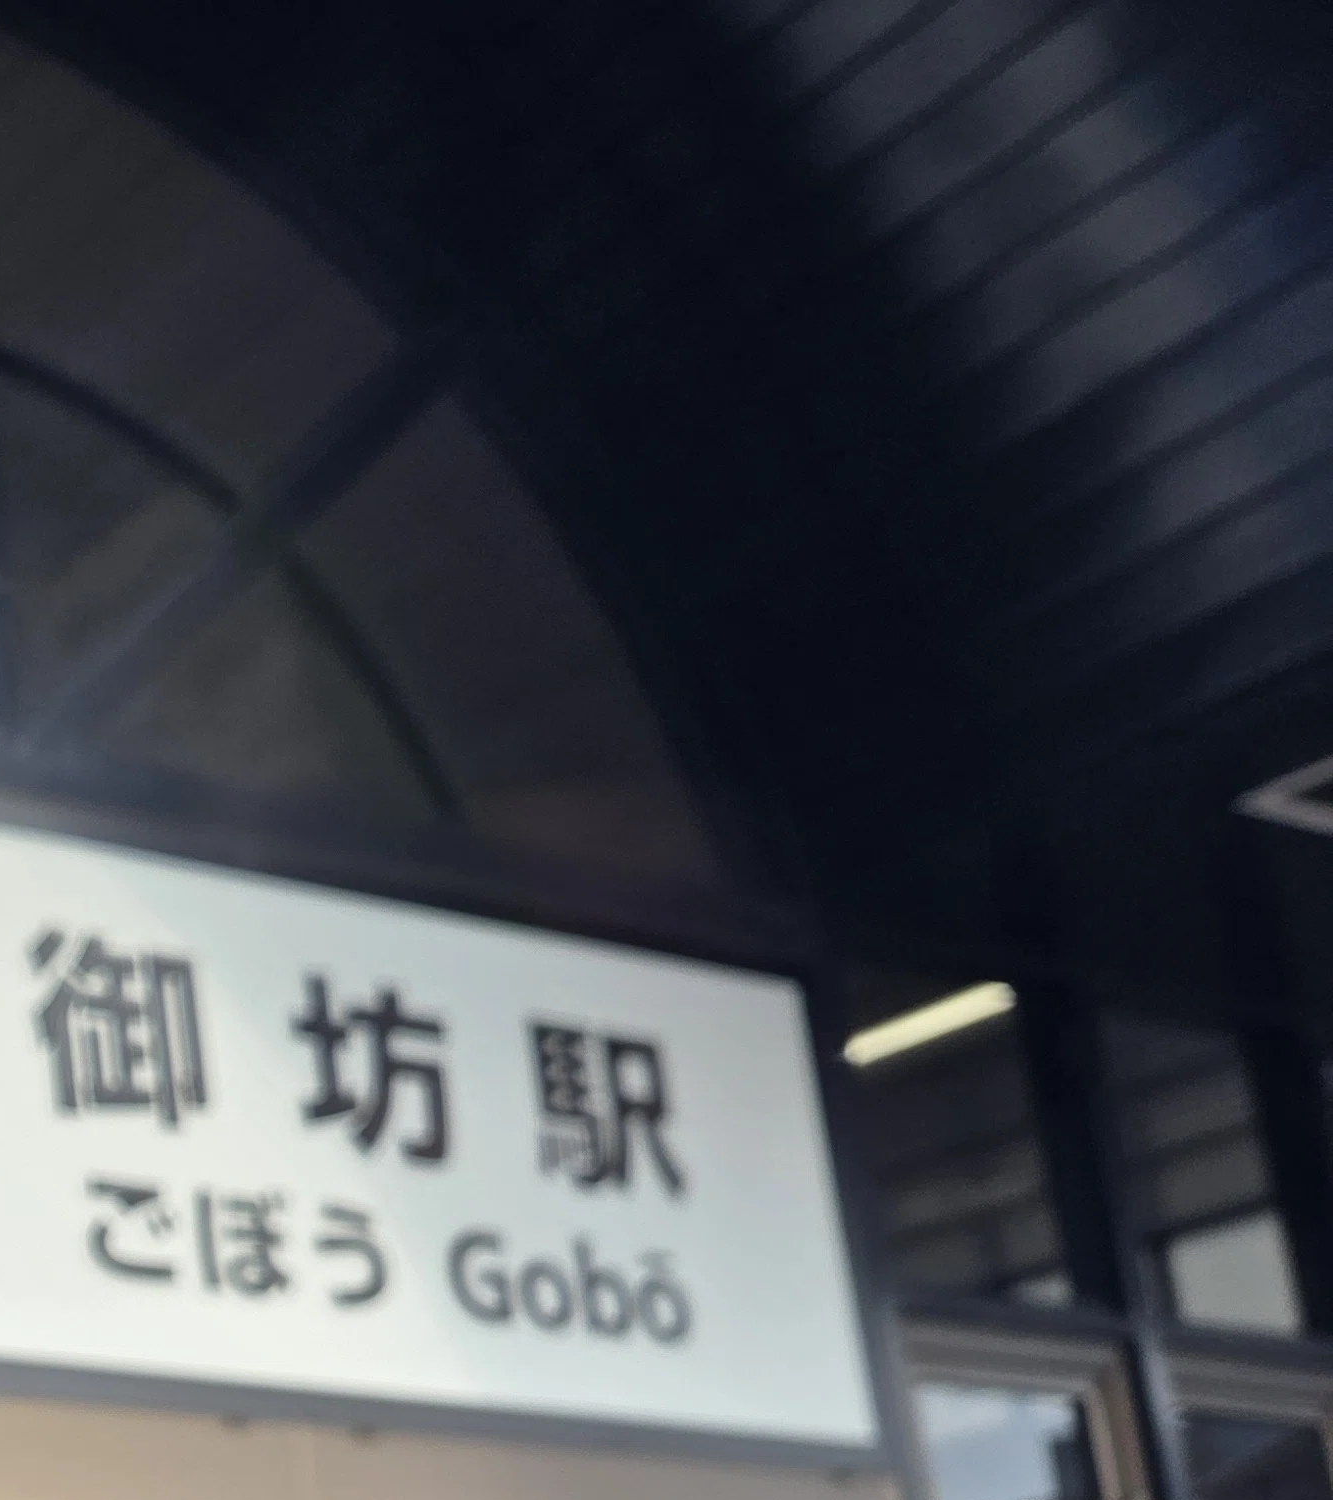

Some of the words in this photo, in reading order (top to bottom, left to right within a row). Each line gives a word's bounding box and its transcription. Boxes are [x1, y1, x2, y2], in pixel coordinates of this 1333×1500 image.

[28, 929, 685, 1197] 御坊駅
[85, 1176, 388, 1306] ごぼう
[447, 1230, 692, 1345] Gobō
